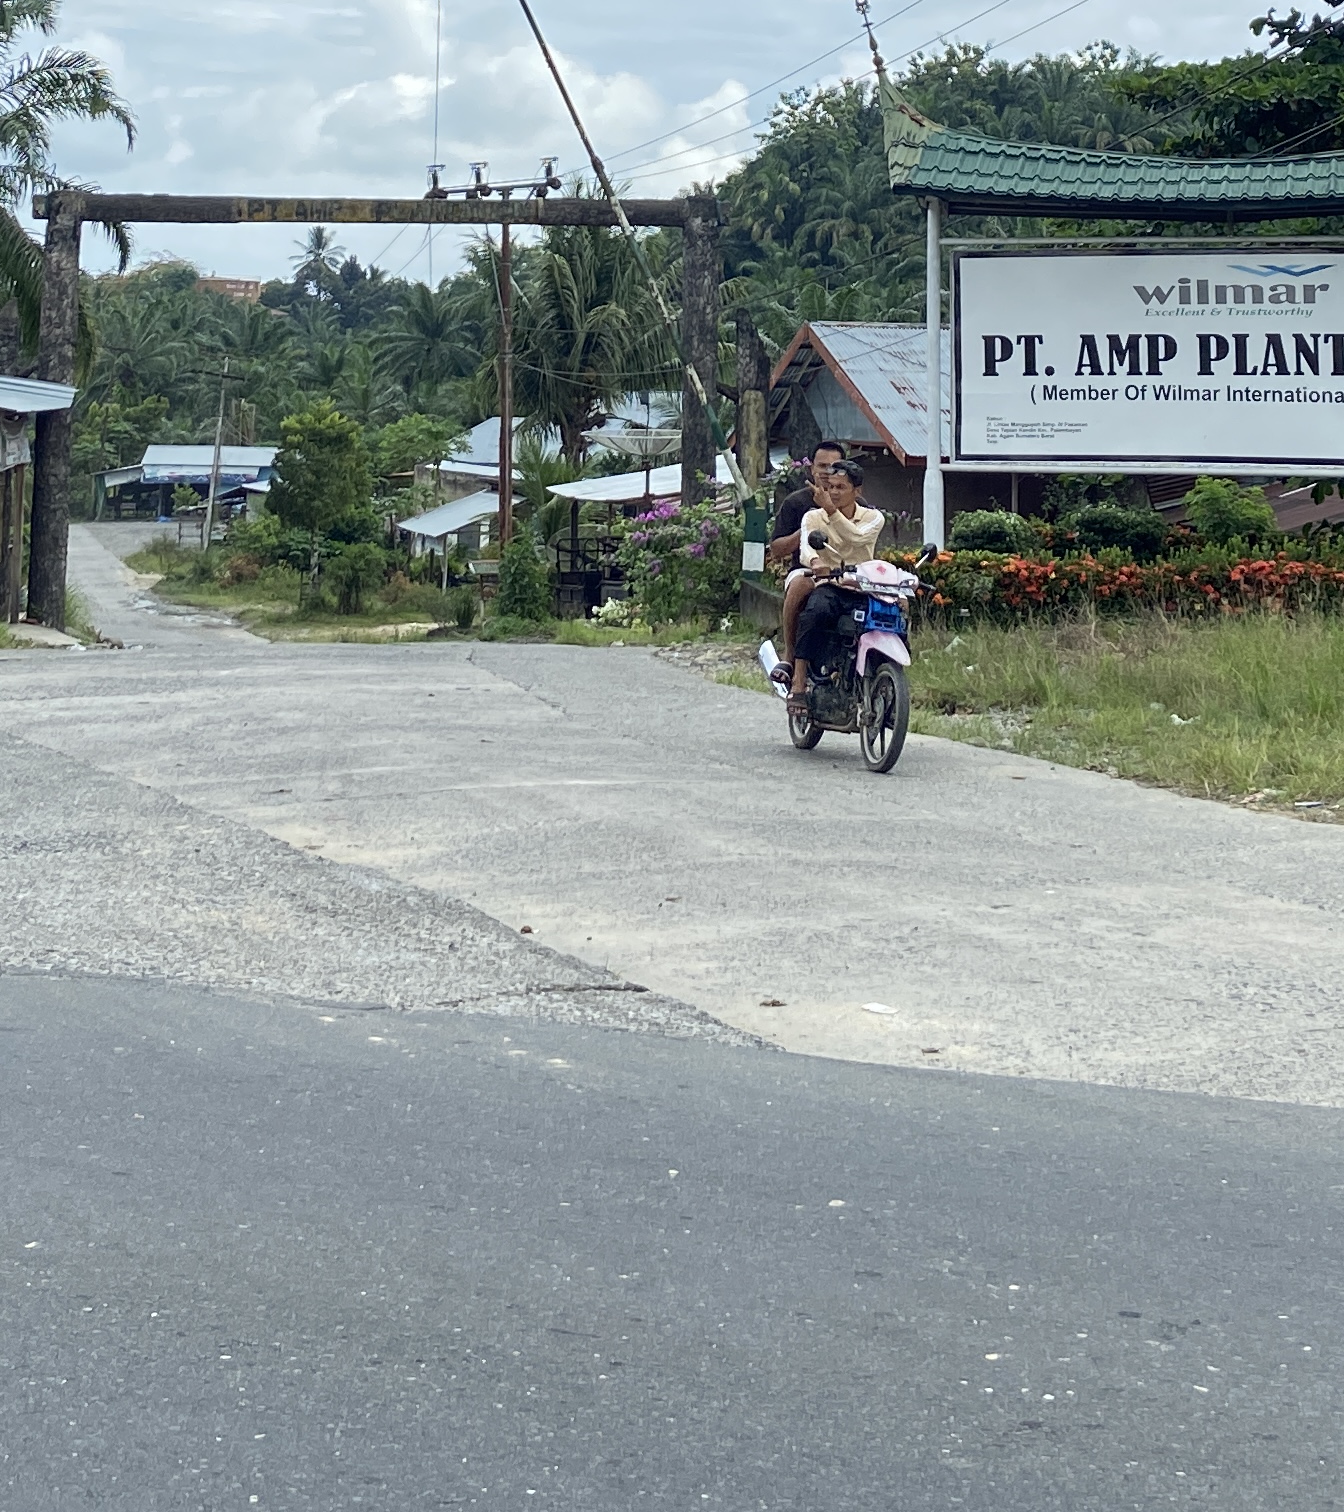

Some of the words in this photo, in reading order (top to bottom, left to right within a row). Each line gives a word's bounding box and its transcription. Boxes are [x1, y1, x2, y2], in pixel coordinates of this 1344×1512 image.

[1133, 278, 1330, 305] wilmar
[1145, 307, 1206, 317] Excellent
[1210, 307, 1222, 317] &
[1226, 307, 1315, 318] Trustworthy
[982, 334, 1056, 377] PT.
[1074, 333, 1178, 376] AMP
[1042, 385, 1118, 401] Member
[1125, 384, 1148, 401] Of
[1152, 385, 1220, 402] Wilmar
